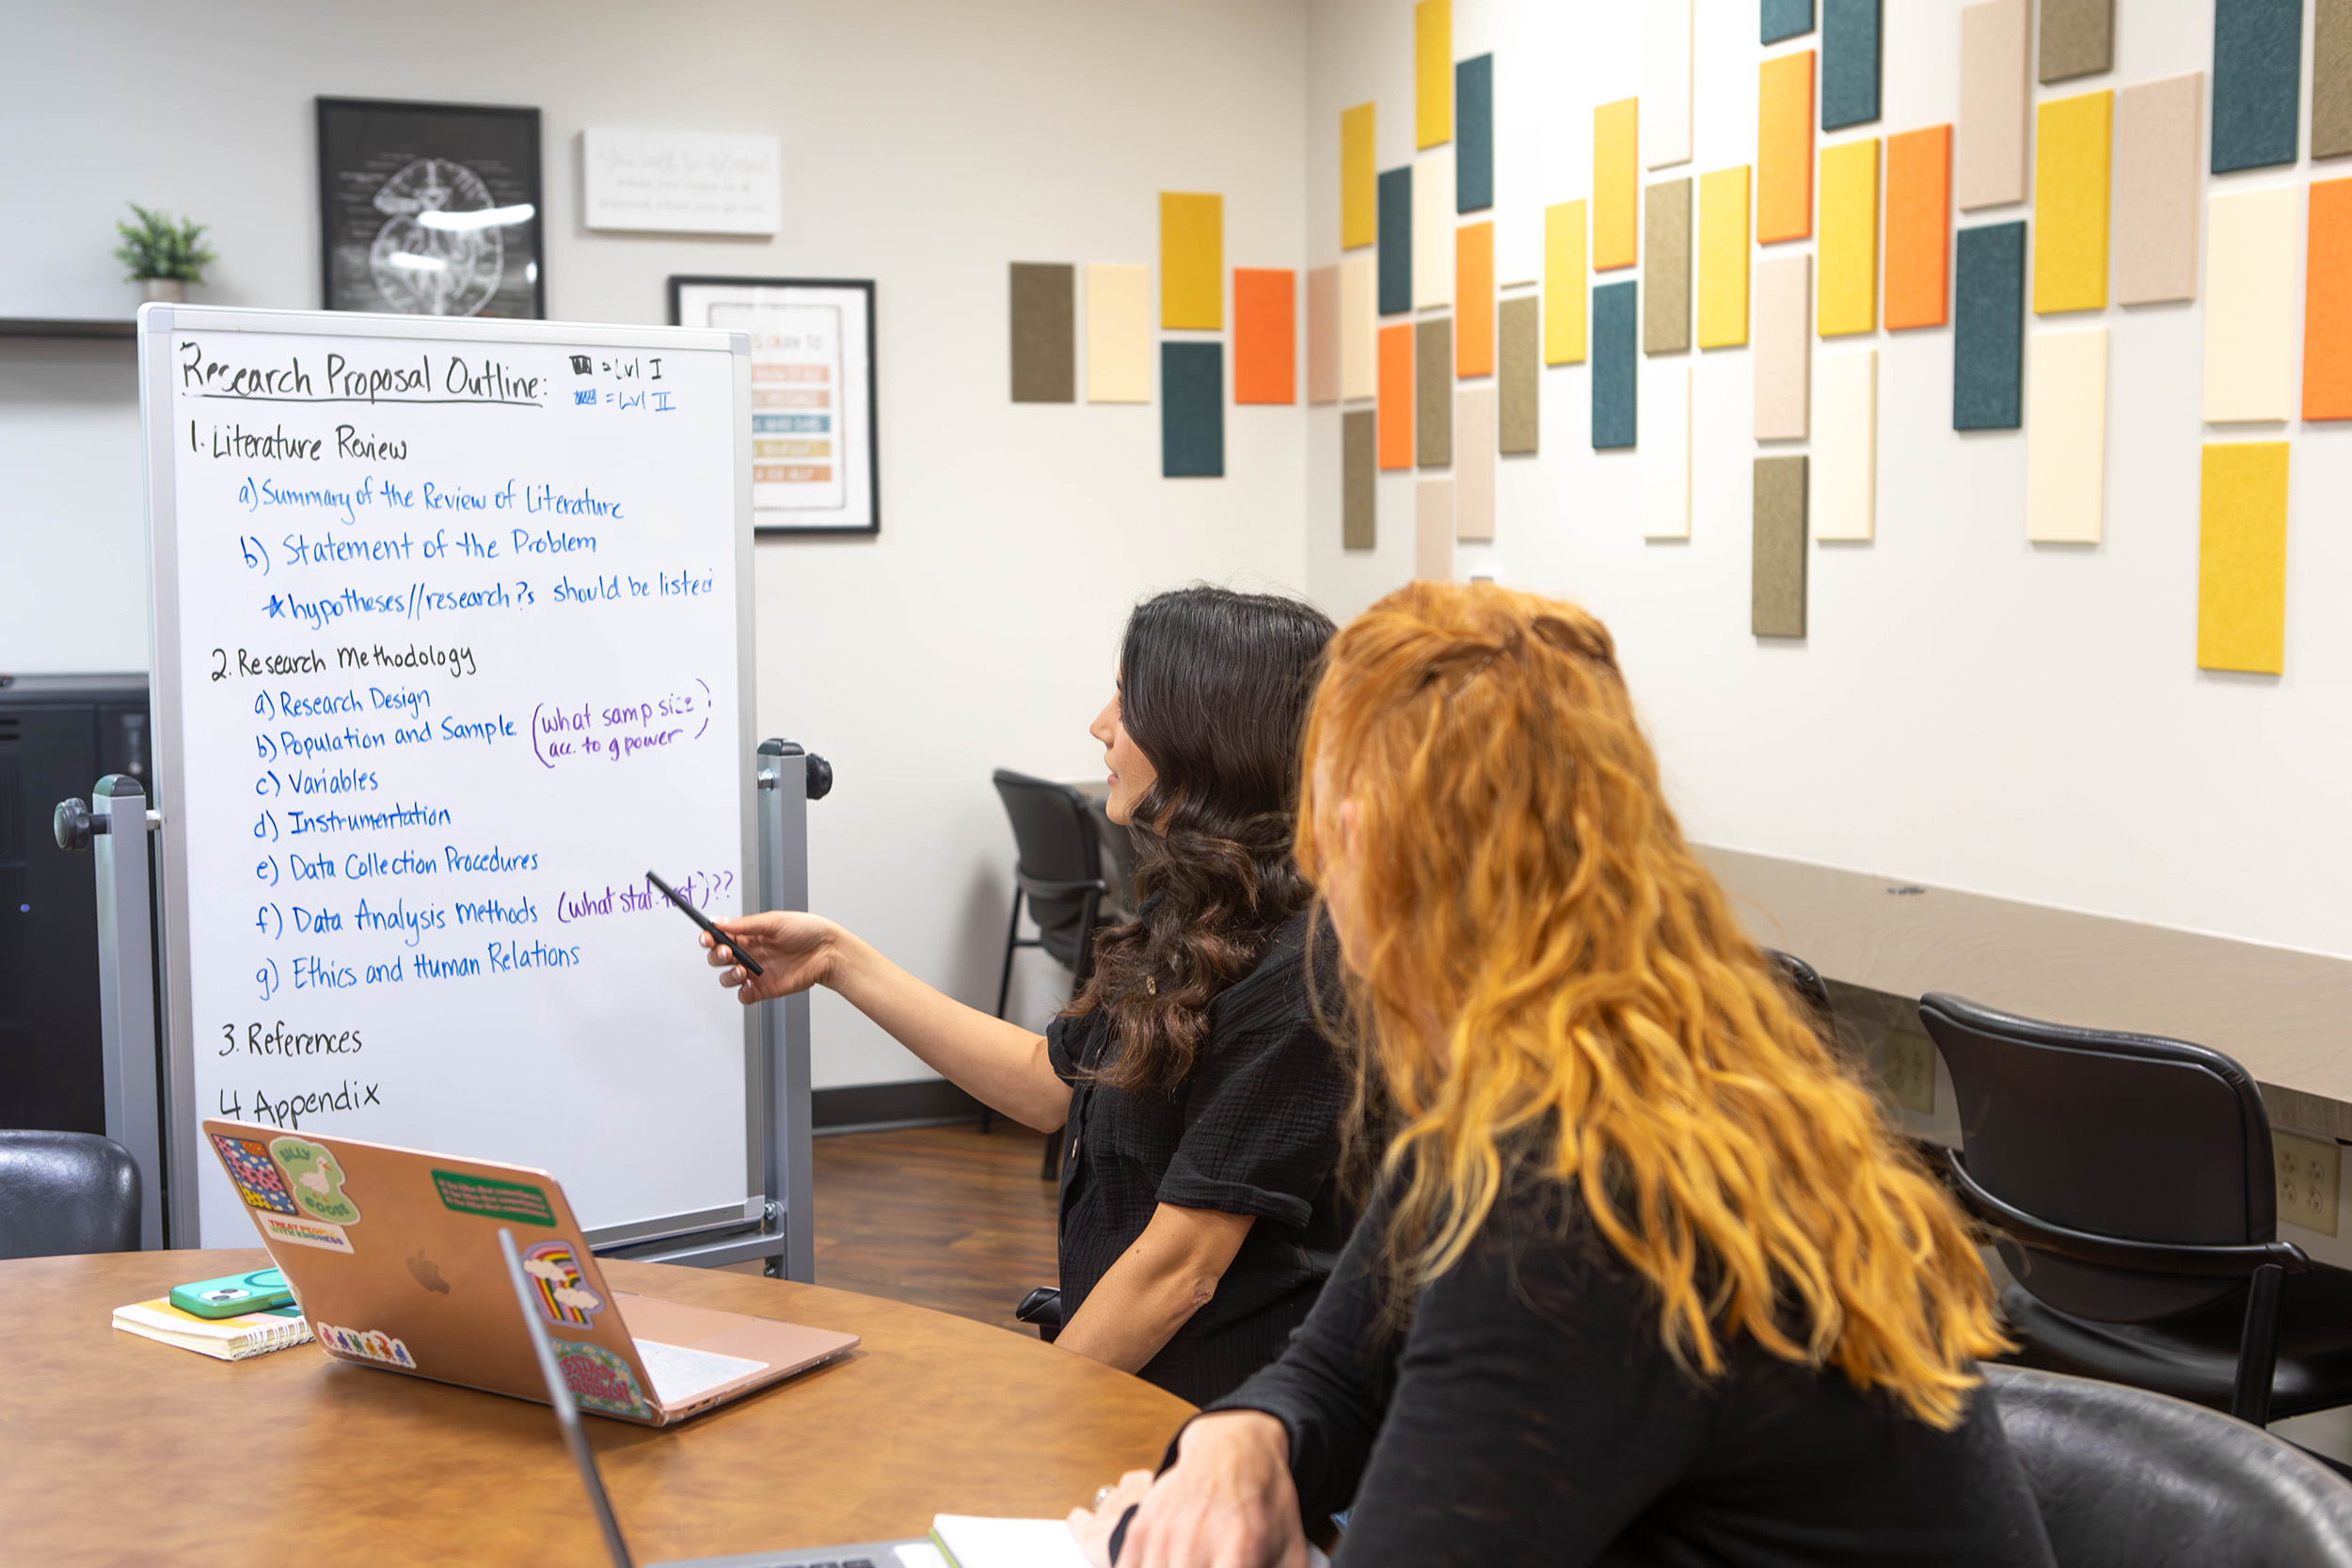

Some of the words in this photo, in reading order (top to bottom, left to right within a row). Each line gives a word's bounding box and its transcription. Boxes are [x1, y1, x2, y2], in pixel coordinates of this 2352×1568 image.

[180, 341, 313, 398] Research
[327, 353, 431, 404] Proposal
[446, 356, 548, 401] Outline:
[191, 420, 205, 452] 1.
[213, 423, 322, 461] Literature
[335, 424, 407, 461] Review
[239, 476, 259, 513] a)
[262, 478, 356, 525] Summary
[357, 475, 373, 505] of
[380, 480, 415, 508] the
[423, 481, 486, 512] Review
[495, 478, 516, 509] of
[527, 483, 624, 519] Literature
[240, 534, 270, 577] b)
[283, 531, 414, 565] Statement
[423, 529, 449, 558] of
[456, 531, 500, 559] the
[511, 528, 596, 555] Problem
[553, 574, 622, 604] should
[628, 575, 650, 597] be
[212, 647, 232, 681] 2.
[238, 647, 326, 677] Research
[254, 689, 276, 721] a)
[280, 689, 363, 718] Research
[369, 686, 431, 720] Design
[602, 703, 653, 728] samp
[257, 734, 277, 763] b)
[280, 727, 386, 759] Population
[395, 721, 433, 745] and
[581, 736, 601, 754] to
[609, 737, 620, 762] g
[256, 769, 280, 798] c)
[289, 768, 378, 795] Variables
[254, 809, 279, 843] d)
[288, 801, 452, 834] Instrumentation
[256, 855, 279, 886] e)
[290, 852, 336, 881] Data
[345, 849, 437, 880] Collection
[444, 845, 539, 874] Procedures
[256, 902, 283, 941] f)
[292, 906, 344, 934] Data
[355, 897, 446, 947] Analysis
[256, 957, 279, 1002] g)
[293, 956, 358, 989] Ethics
[366, 955, 404, 984] and
[414, 953, 481, 979] Human
[487, 939, 580, 973] Relations
[218, 1023, 240, 1056] 3.
[248, 1020, 363, 1057] References
[254, 1080, 381, 1131] Appendix
